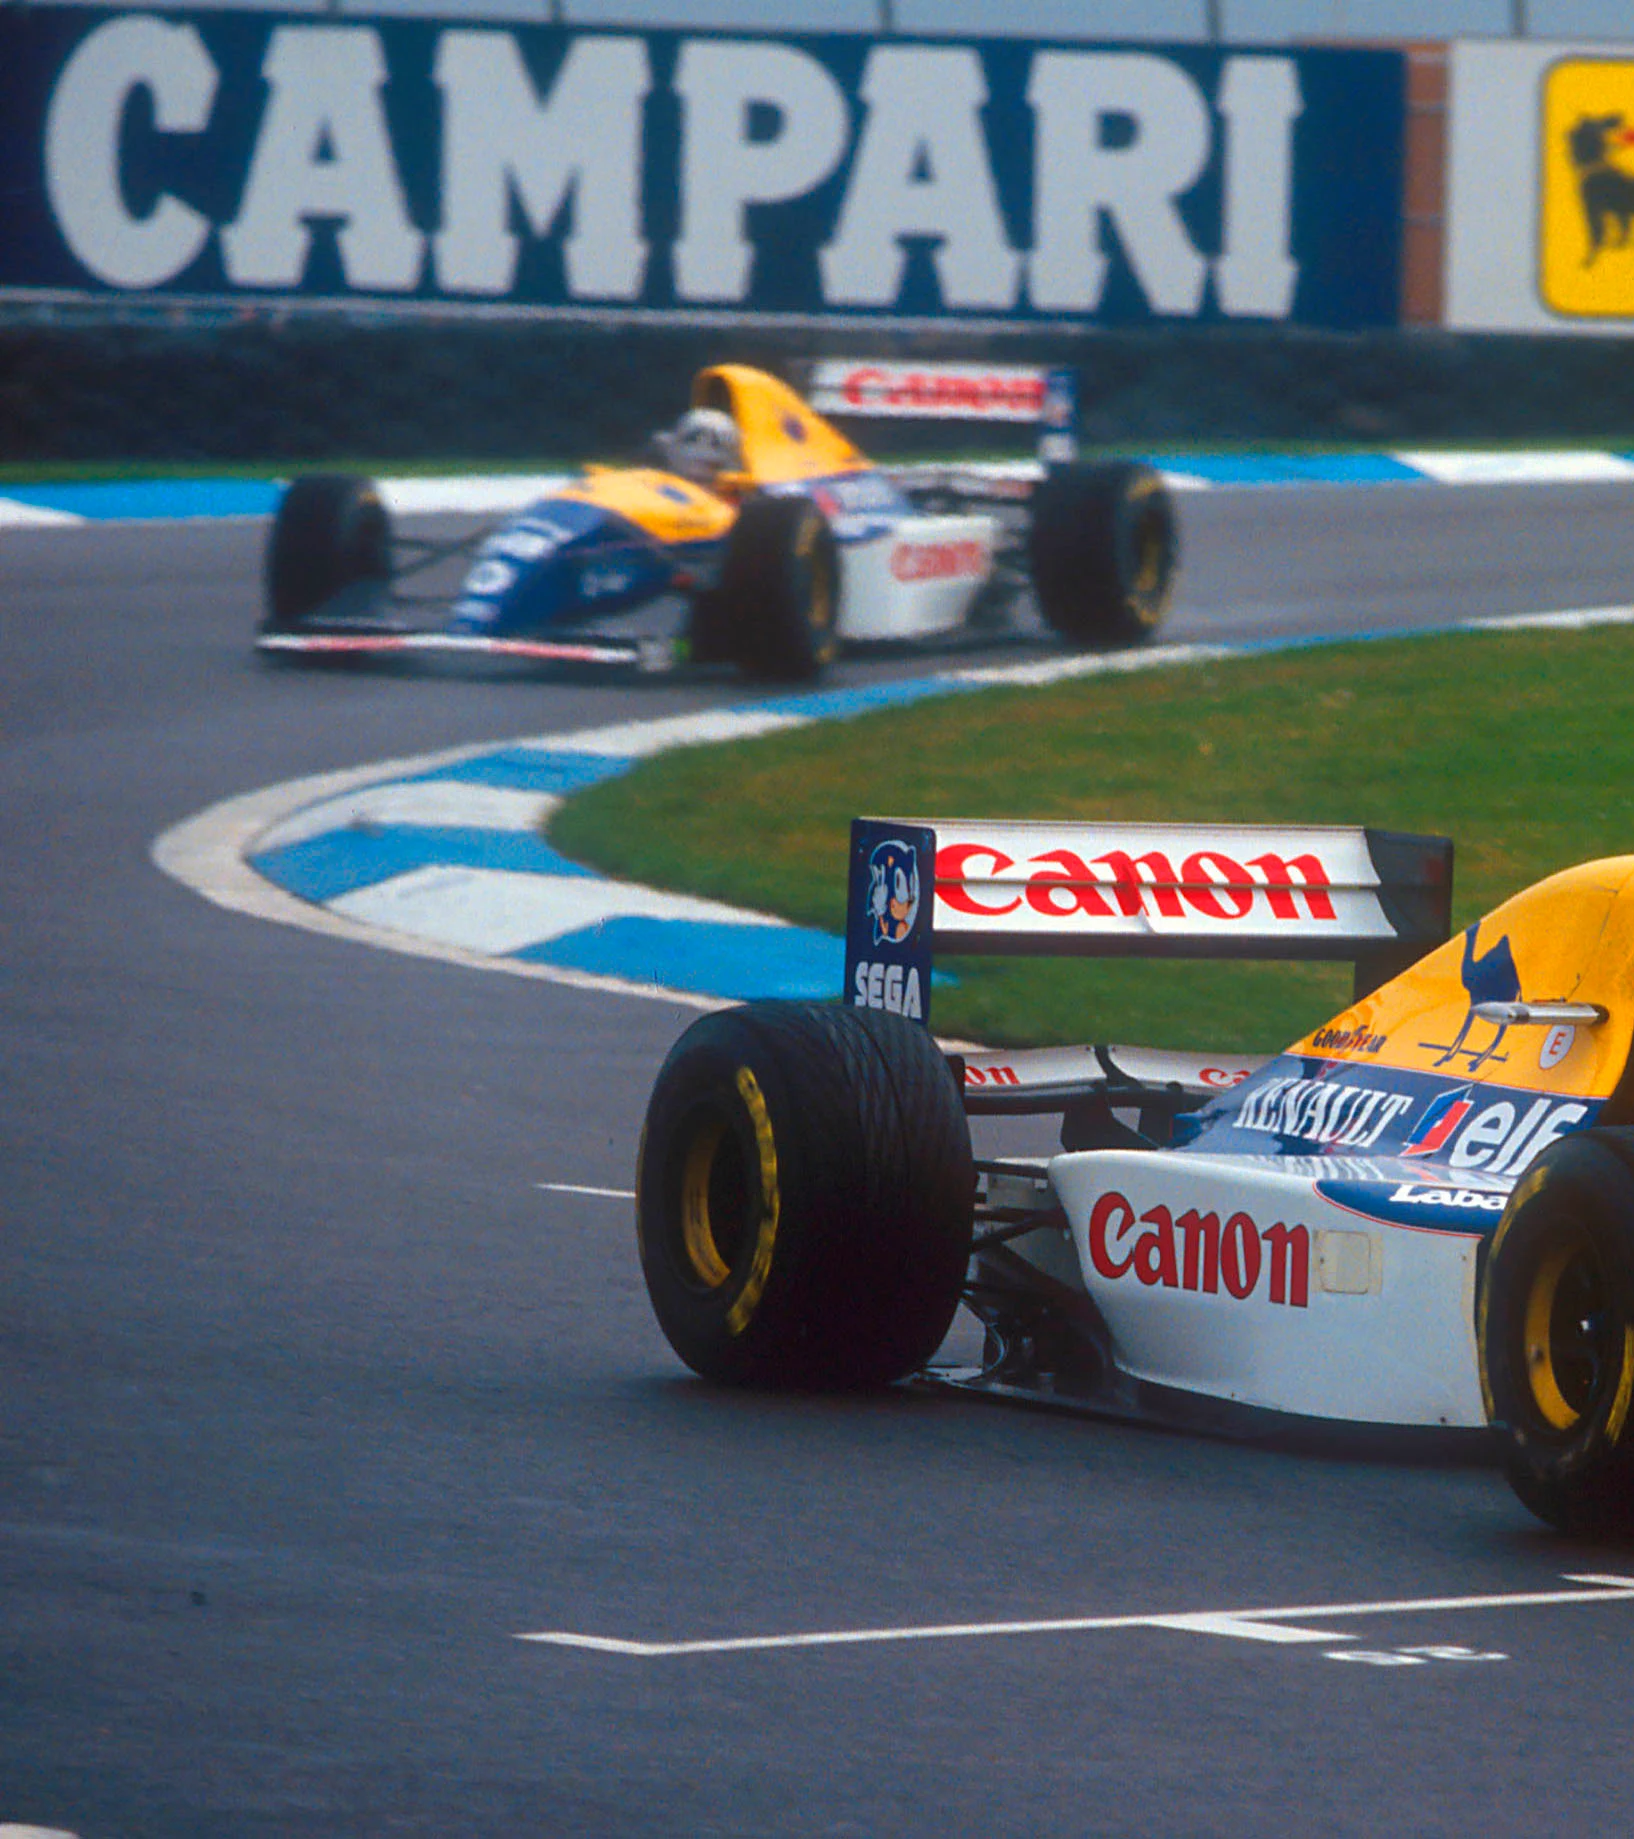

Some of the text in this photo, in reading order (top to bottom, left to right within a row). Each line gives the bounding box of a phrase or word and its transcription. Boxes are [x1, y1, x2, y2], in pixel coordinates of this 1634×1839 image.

[43, 13, 1302, 319] CAMPARI
[933, 843, 1338, 921] Canon
[854, 961, 923, 1020] SEGA
[1312, 1024, 1388, 1053] GOODYEAR
[1547, 1031, 1566, 1055] E
[1232, 1077, 1414, 1148] RENAULT
[1449, 1099, 1588, 1177] elf
[1389, 1184, 1508, 1211] Laba
[1089, 1191, 1310, 1308] Canon
